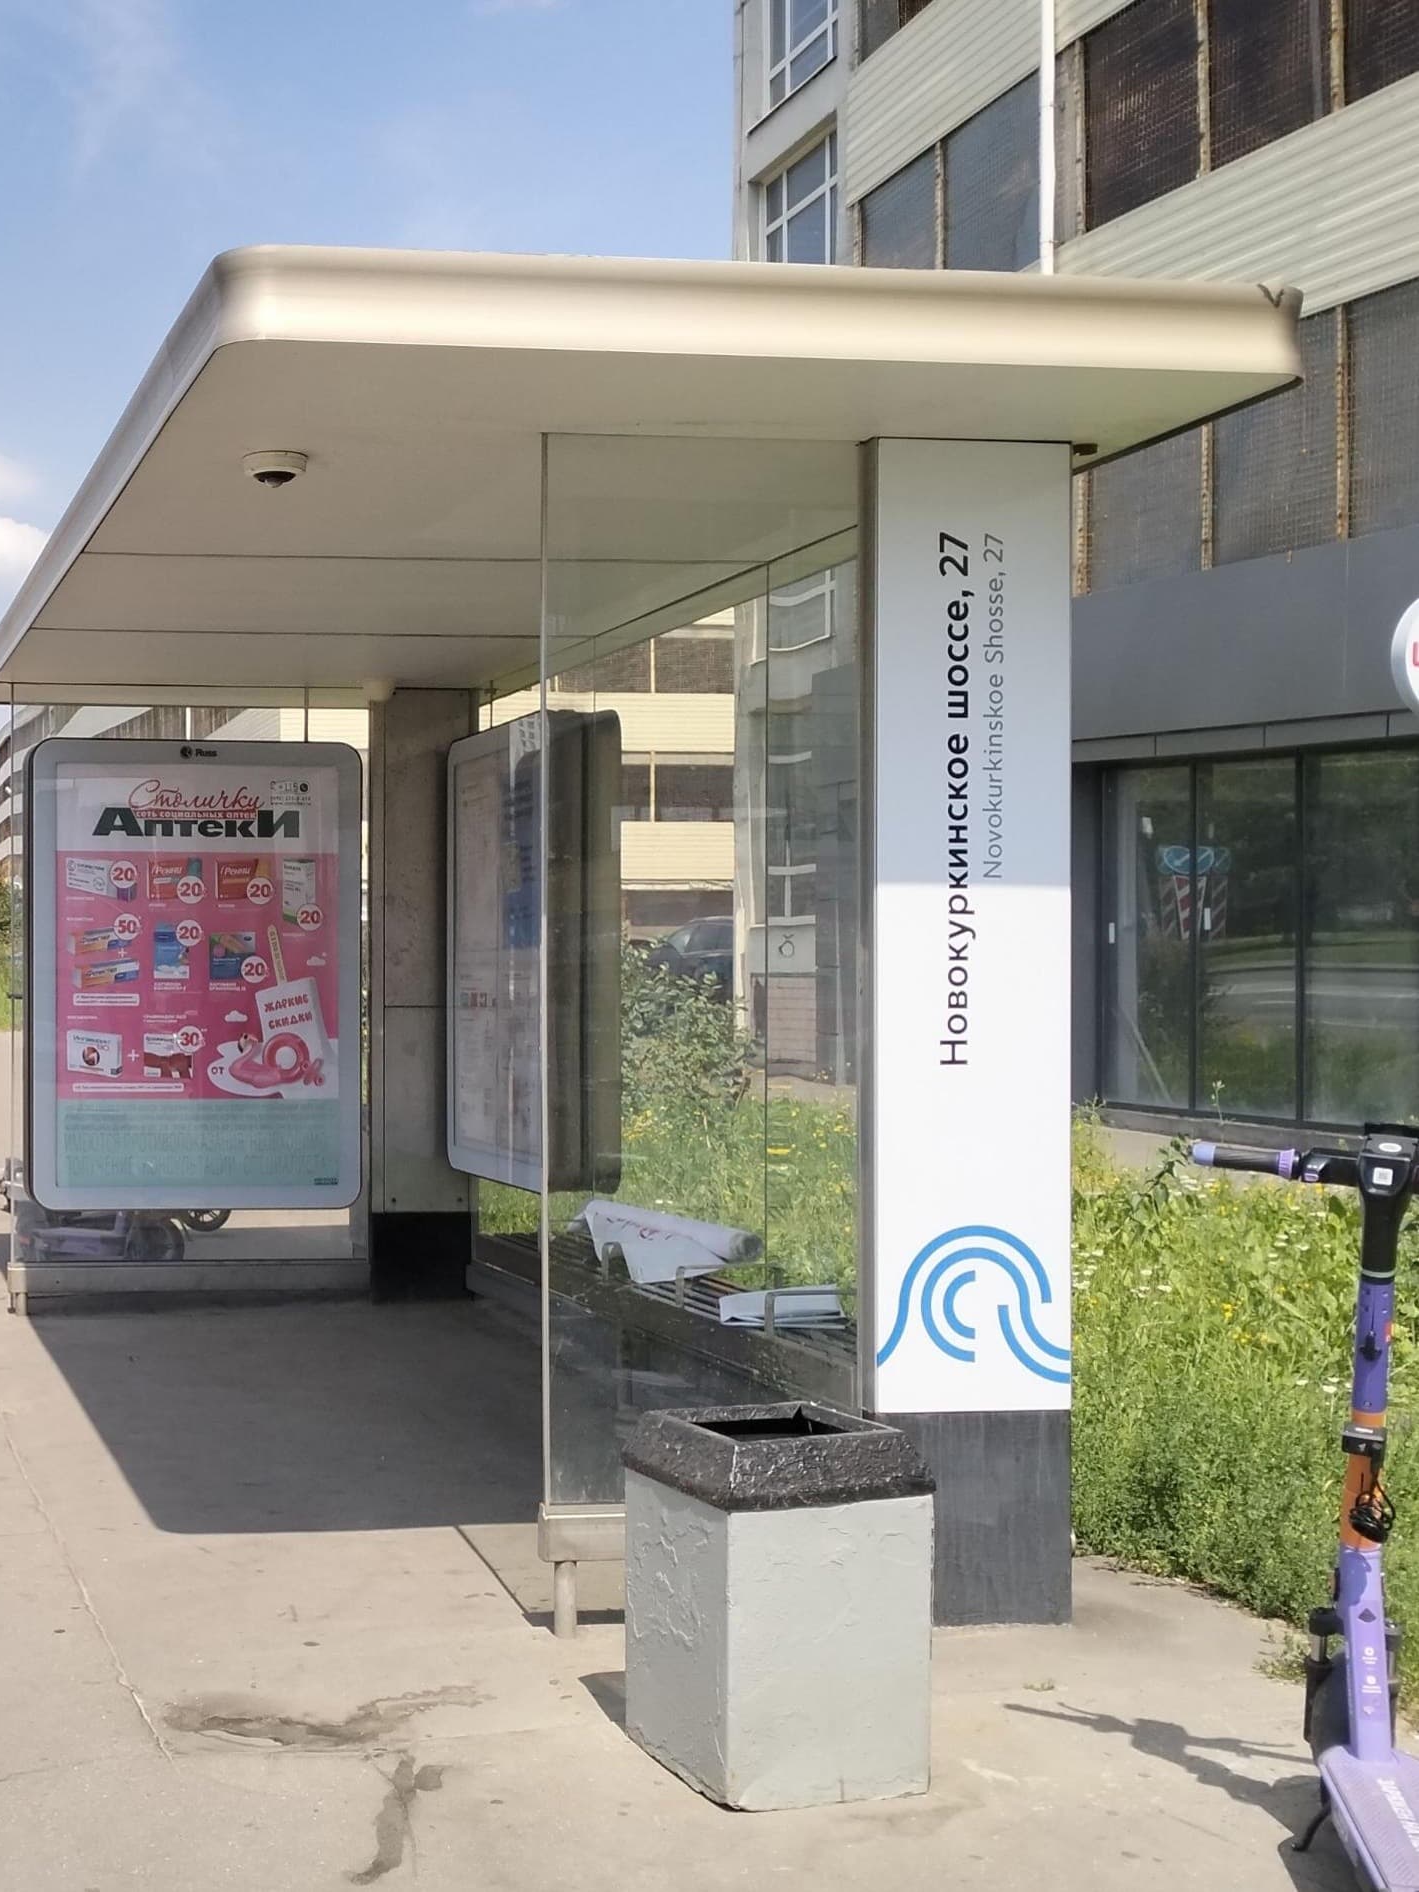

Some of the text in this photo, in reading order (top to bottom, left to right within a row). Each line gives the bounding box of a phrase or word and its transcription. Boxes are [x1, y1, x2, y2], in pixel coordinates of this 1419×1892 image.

[982, 533, 1007, 879] Novokurkinskoe Shosse, 27
[195, 748, 218, 758] Russ
[129, 779, 265, 809] Столички
[939, 532, 976, 1066] Новокуркинское шоссе, 27
[136, 810, 257, 820] сеть социальных аптек
[264, 993, 309, 1013] ЖАРКИЕ
[268, 1011, 313, 1030] СКИДКИ
